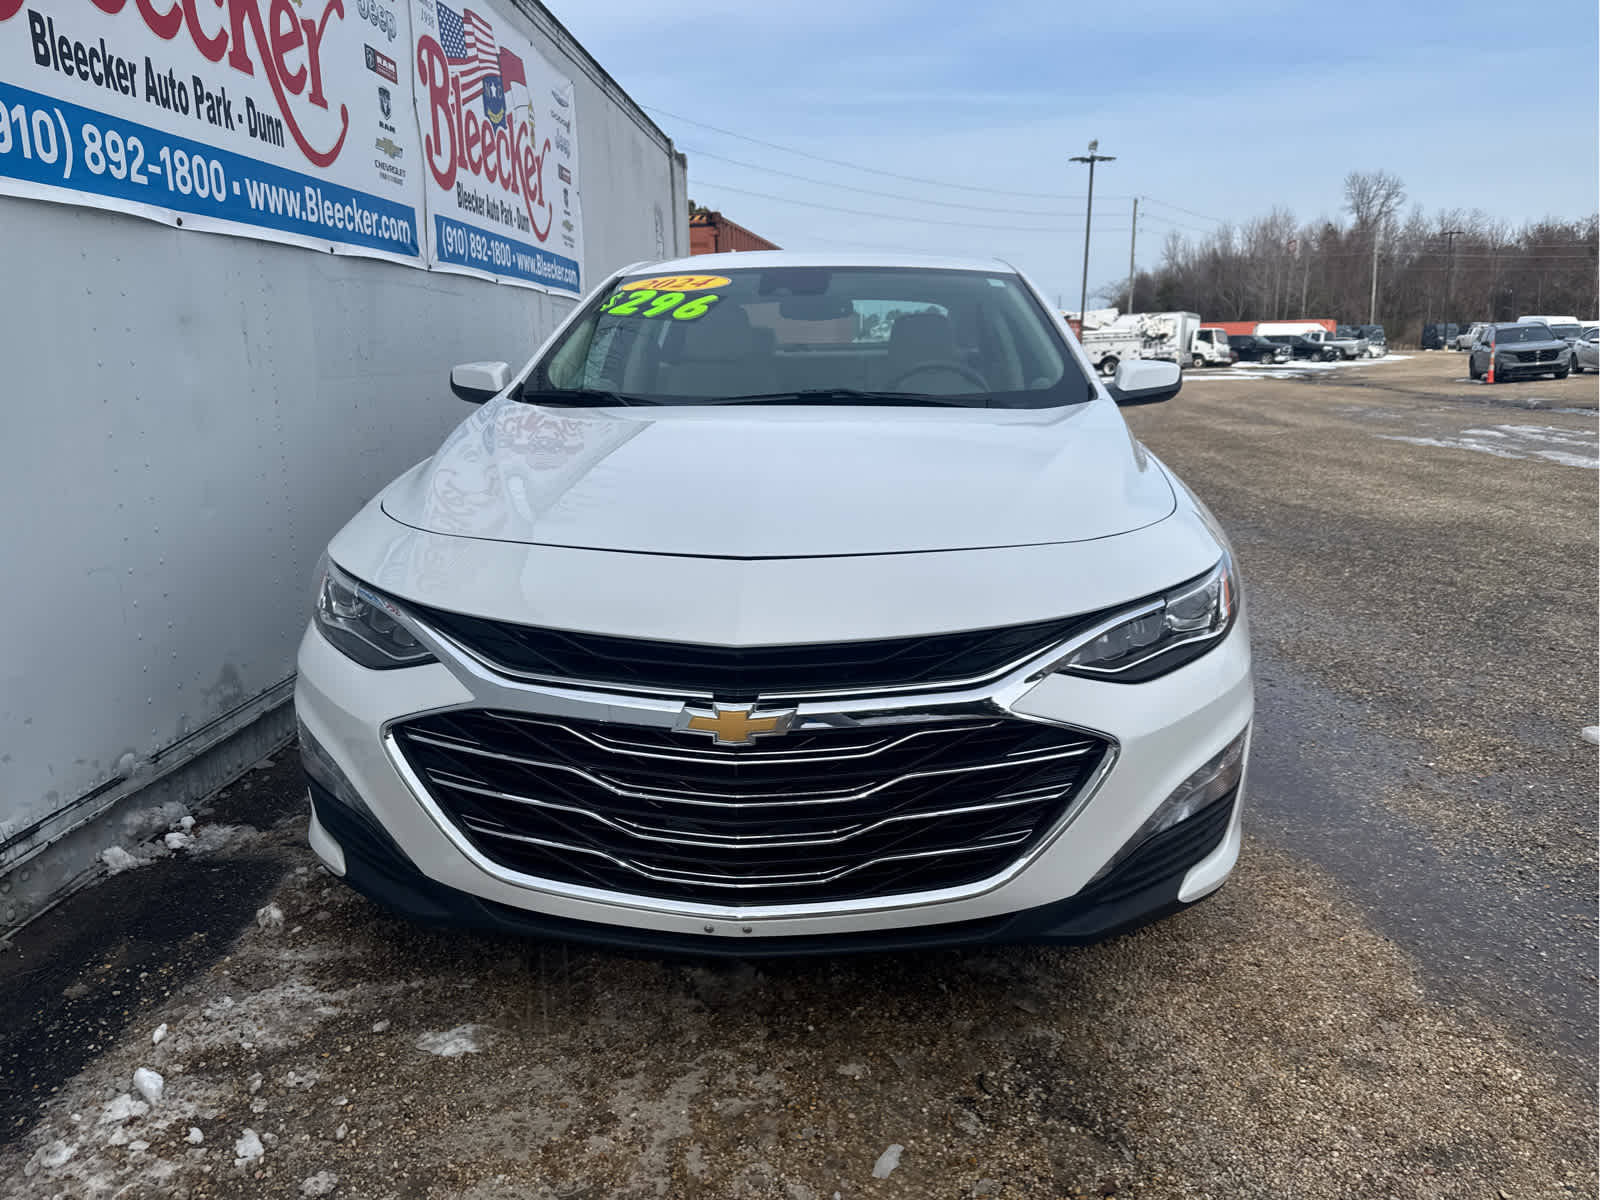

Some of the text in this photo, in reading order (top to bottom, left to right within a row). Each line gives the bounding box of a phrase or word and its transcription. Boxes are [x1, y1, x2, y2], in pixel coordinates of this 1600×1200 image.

[28, 8, 137, 98] Bleecker
[145, 55, 189, 116] Auto
[192, 75, 236, 132] Park
[246, 95, 285, 148] Dunn
[379, 120, 396, 134] RAM
[417, 34, 552, 242] Bleecker
[82, 123, 227, 203] 892-1800
[245, 177, 412, 245] www.Bleecker.com
[456, 181, 485, 216] Bleecker
[485, 194, 500, 222] Auto
[500, 200, 513, 228] Park
[516, 207, 530, 233] Dunn
[442, 221, 468, 262] (910)
[469, 233, 511, 267] 892-1800
[516, 252, 578, 286] www.Bleecker.com
[600, 290, 720, 319] $296
[635, 277, 718, 291] 2024
